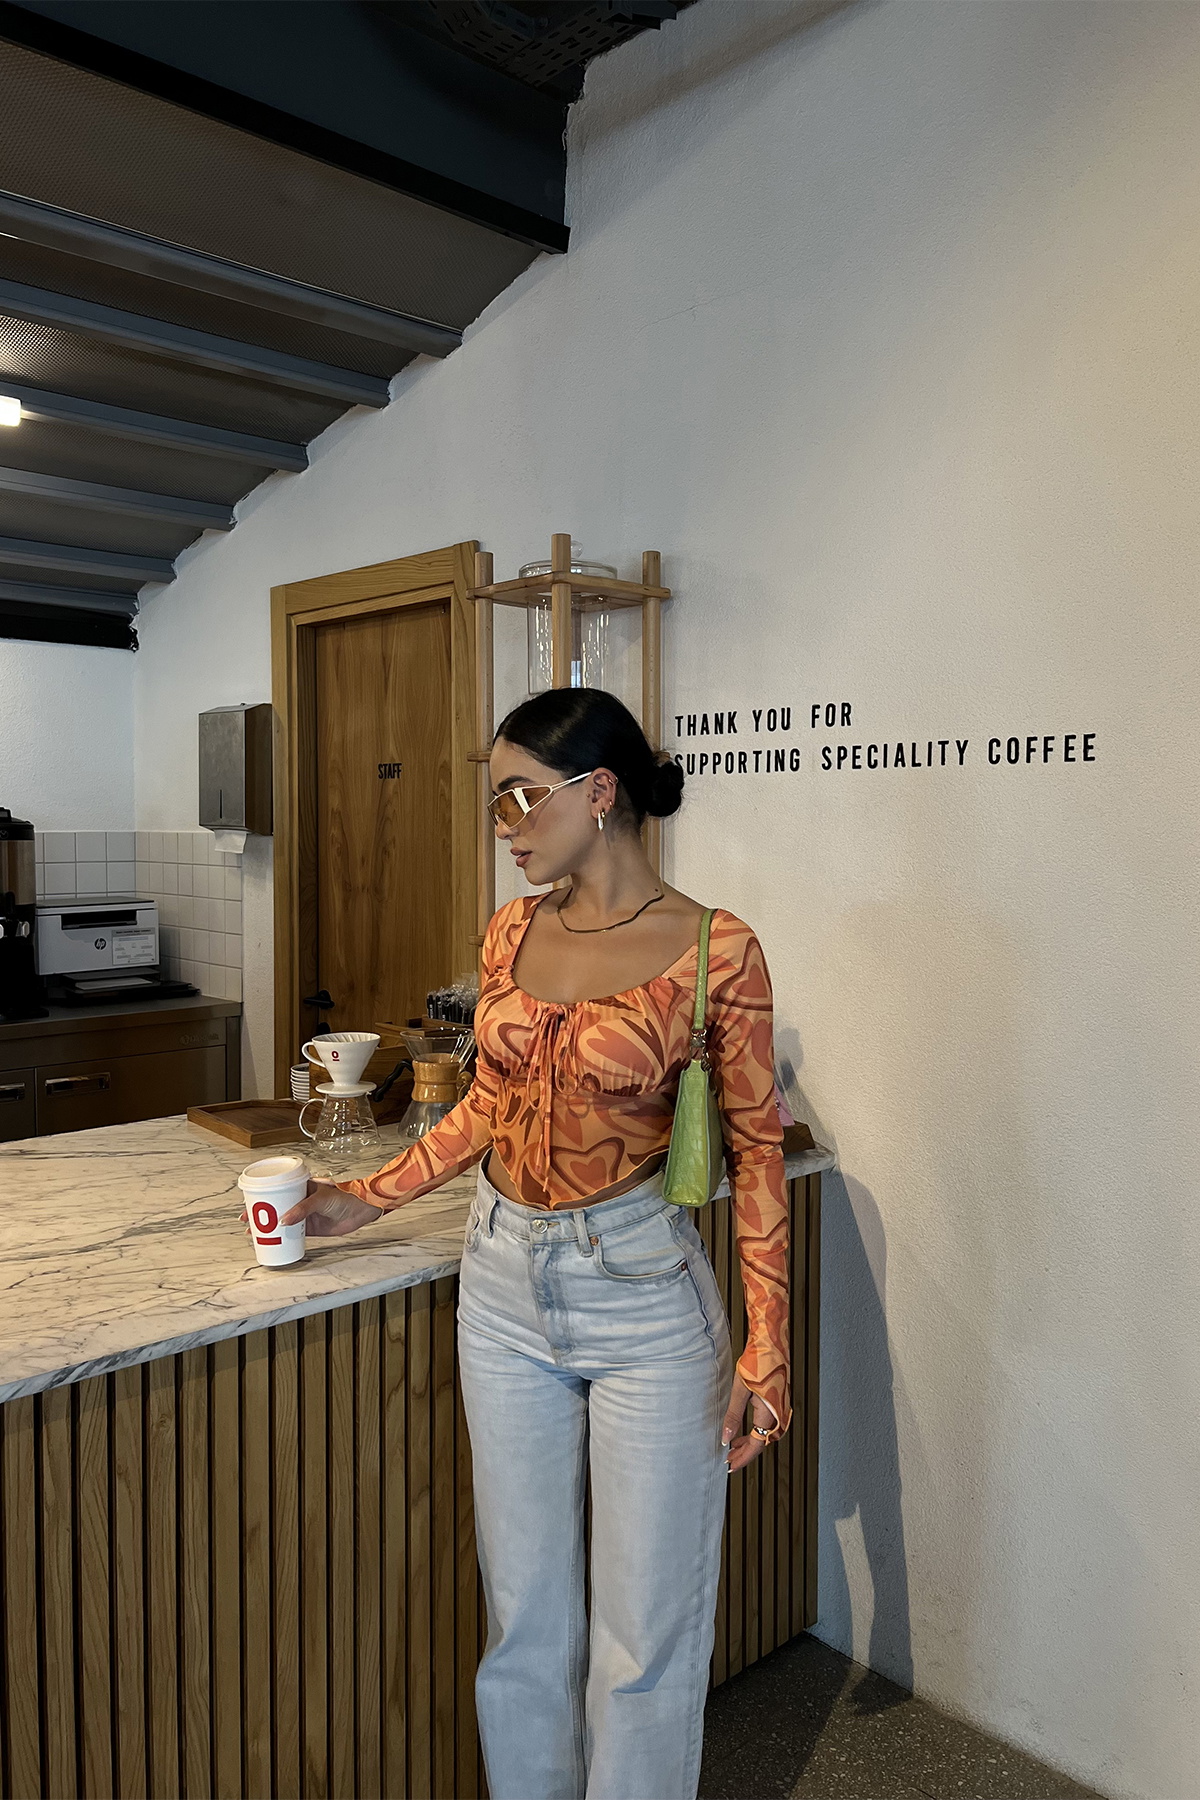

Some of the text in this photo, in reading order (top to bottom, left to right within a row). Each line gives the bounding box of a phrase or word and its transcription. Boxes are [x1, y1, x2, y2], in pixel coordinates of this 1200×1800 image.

[674, 702, 852, 738] THANK YOU FOR
[378, 763, 402, 779] STAFF
[674, 733, 1096, 777] SUPPORTING SPECIALITY COFFEE
